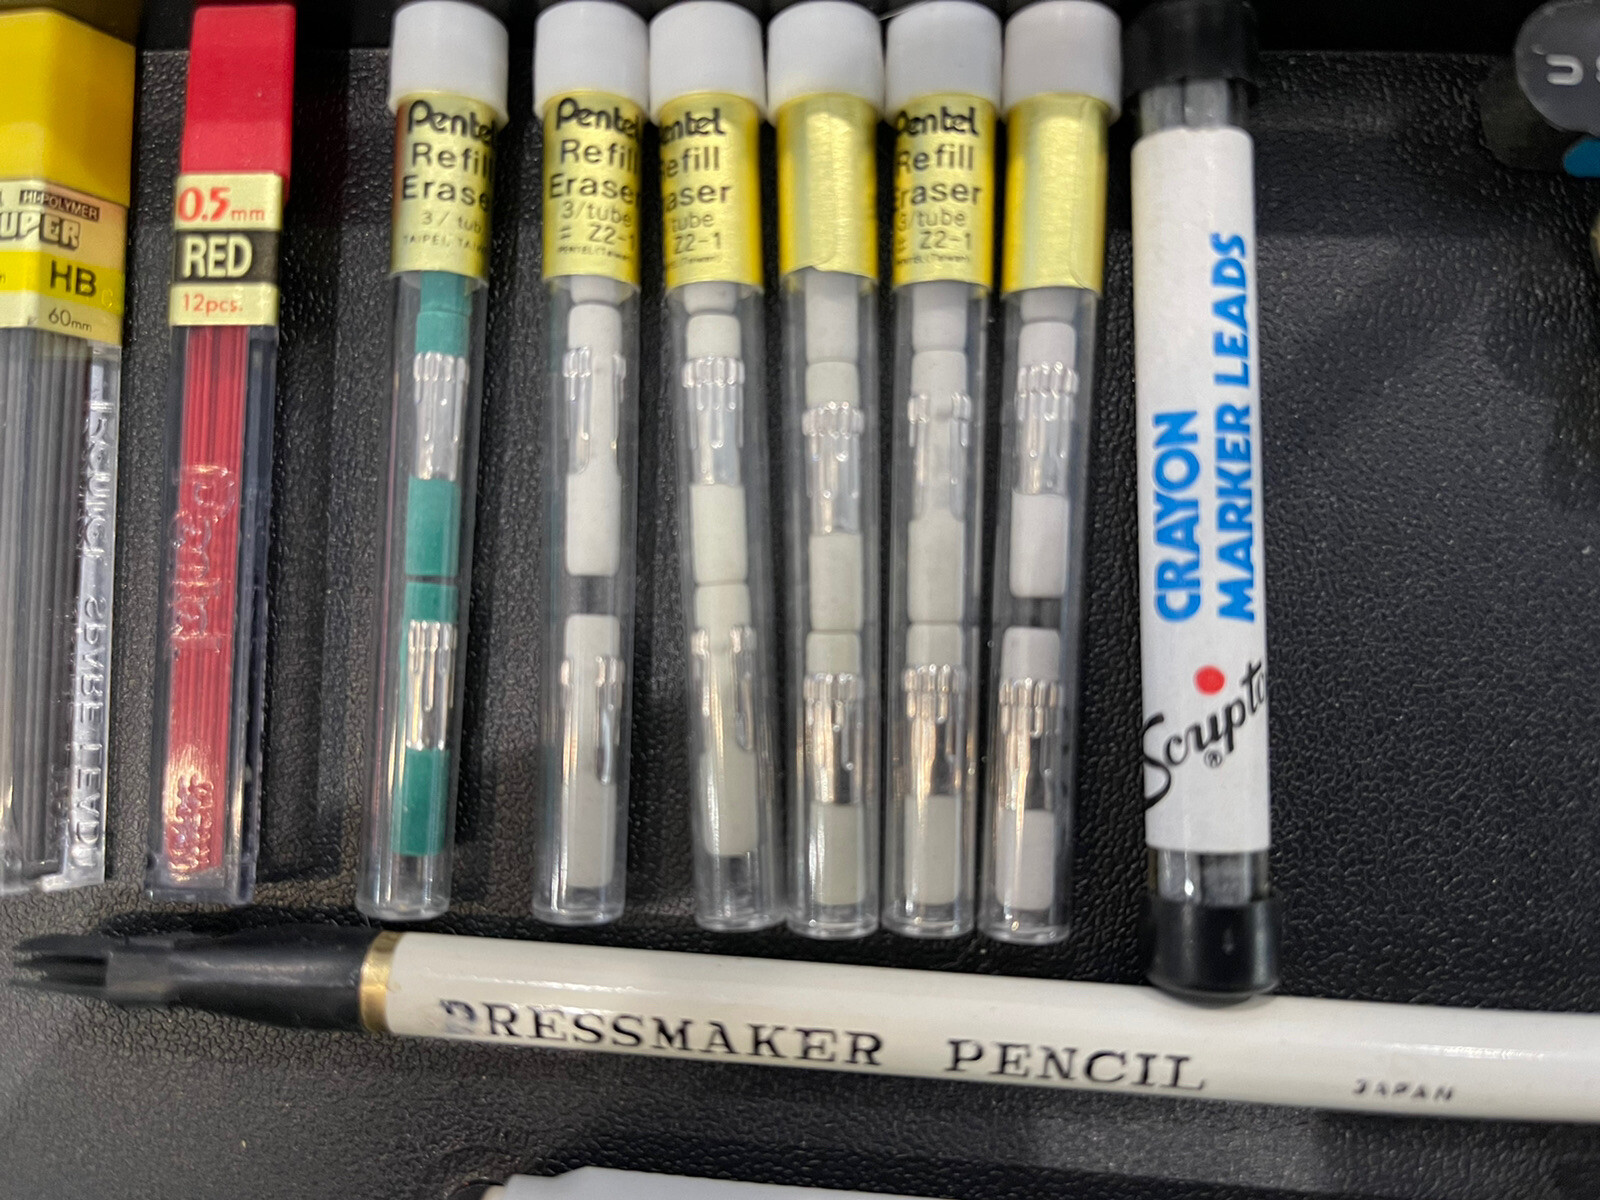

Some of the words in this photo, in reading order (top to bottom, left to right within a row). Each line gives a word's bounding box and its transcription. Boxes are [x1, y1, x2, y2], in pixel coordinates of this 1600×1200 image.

[550, 172, 641, 205] Erase
[0, 211, 80, 251] UPER
[183, 233, 253, 279] RED
[50, 259, 97, 298] HB
[48, 307, 92, 333] 60mm
[1210, 232, 1250, 389] LEADS
[1153, 410, 1201, 623] CRAYON
[1215, 402, 1255, 624] MARKER
[944, 1037, 1205, 1091] PENCIL
[1353, 1078, 1453, 1101] JAPAN
